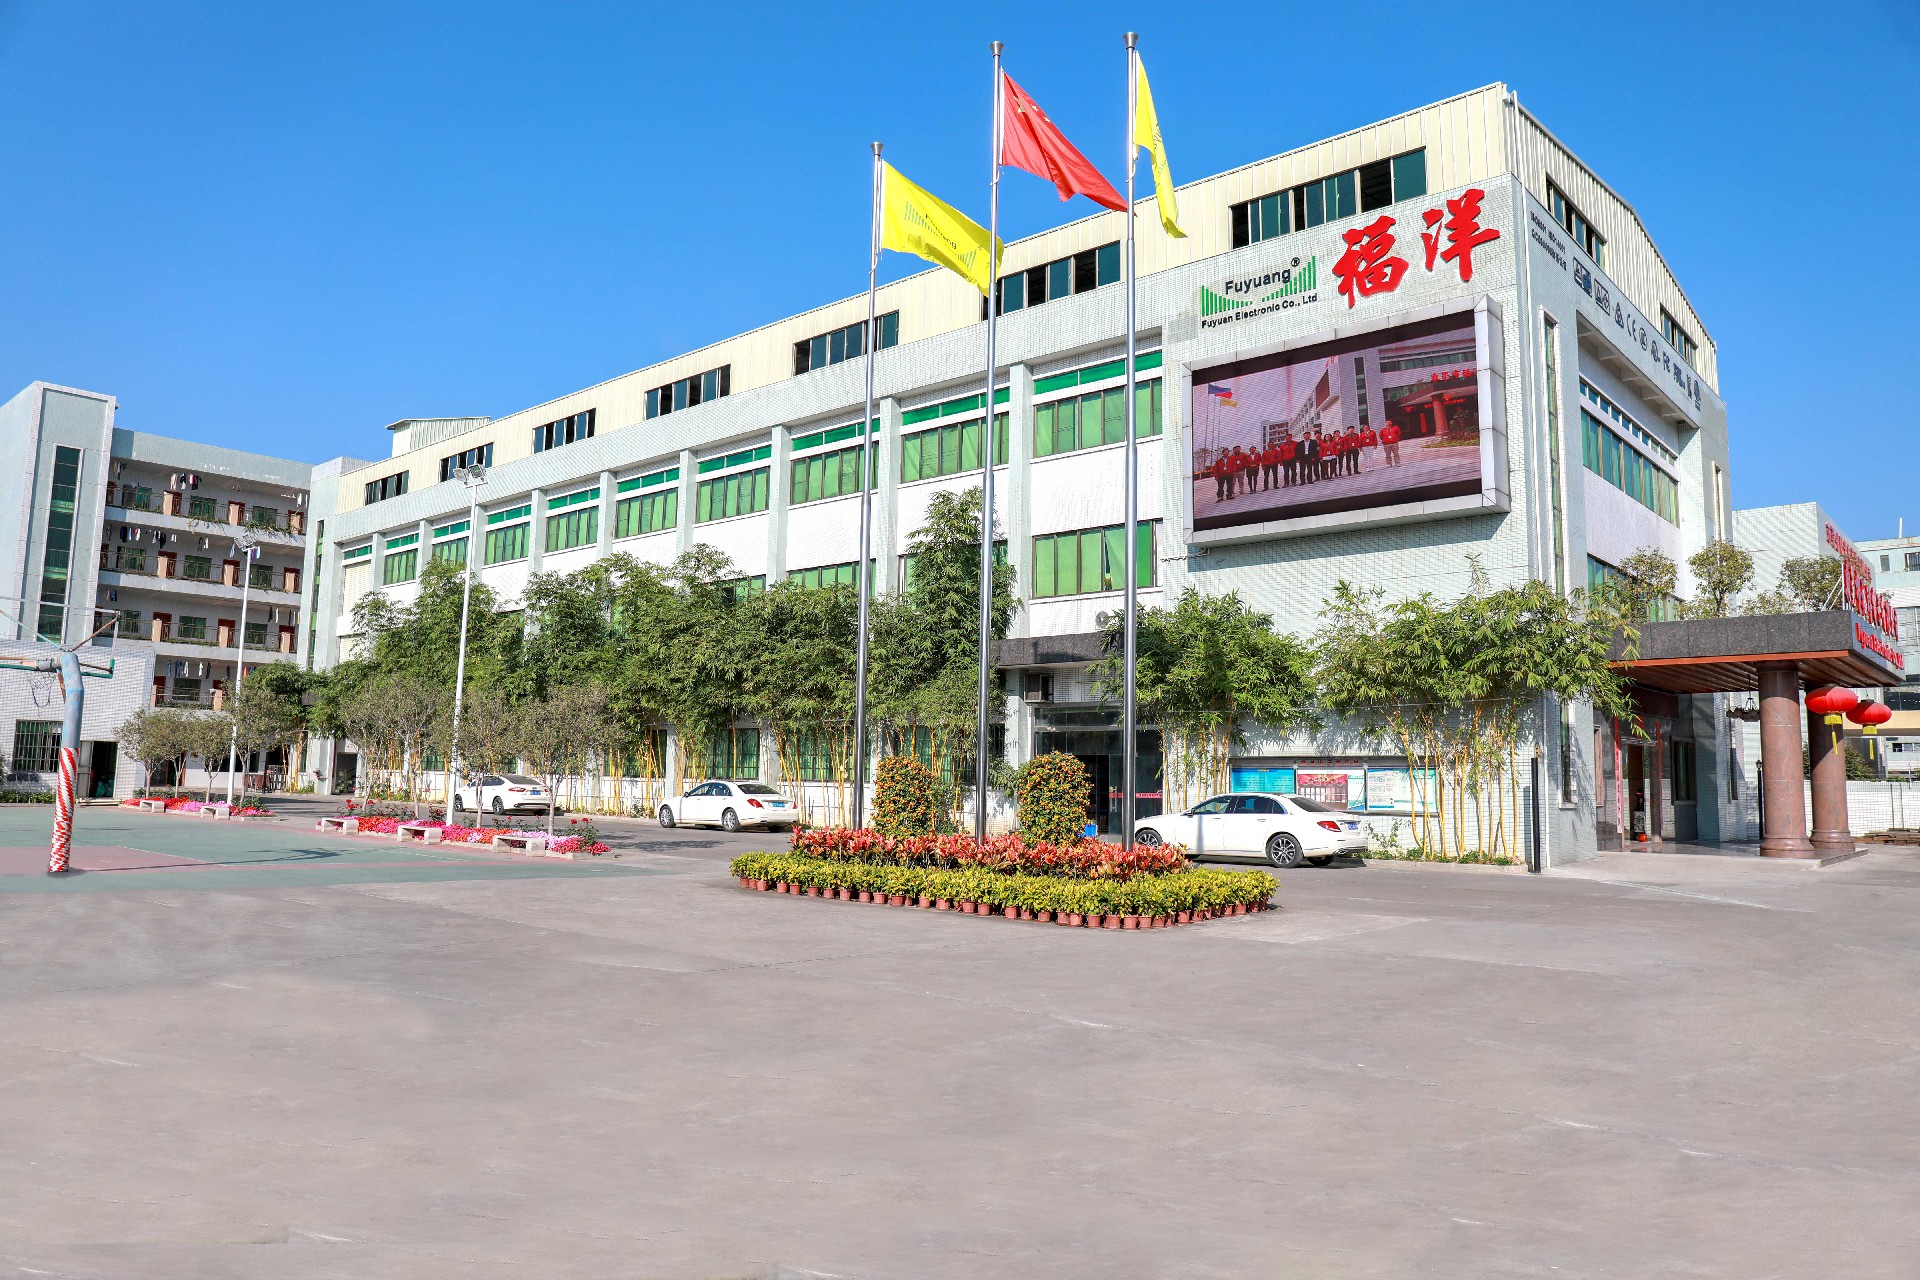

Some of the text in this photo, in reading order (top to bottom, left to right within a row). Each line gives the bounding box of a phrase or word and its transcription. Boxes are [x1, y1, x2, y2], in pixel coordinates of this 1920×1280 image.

[1332, 188, 1500, 308] 福洋
[1225, 269, 1291, 295] Fuyuang
[1201, 315, 1233, 329] Fuyuan
[1235, 303, 1280, 321] Electronic
[1302, 293, 1318, 305] Ltd
